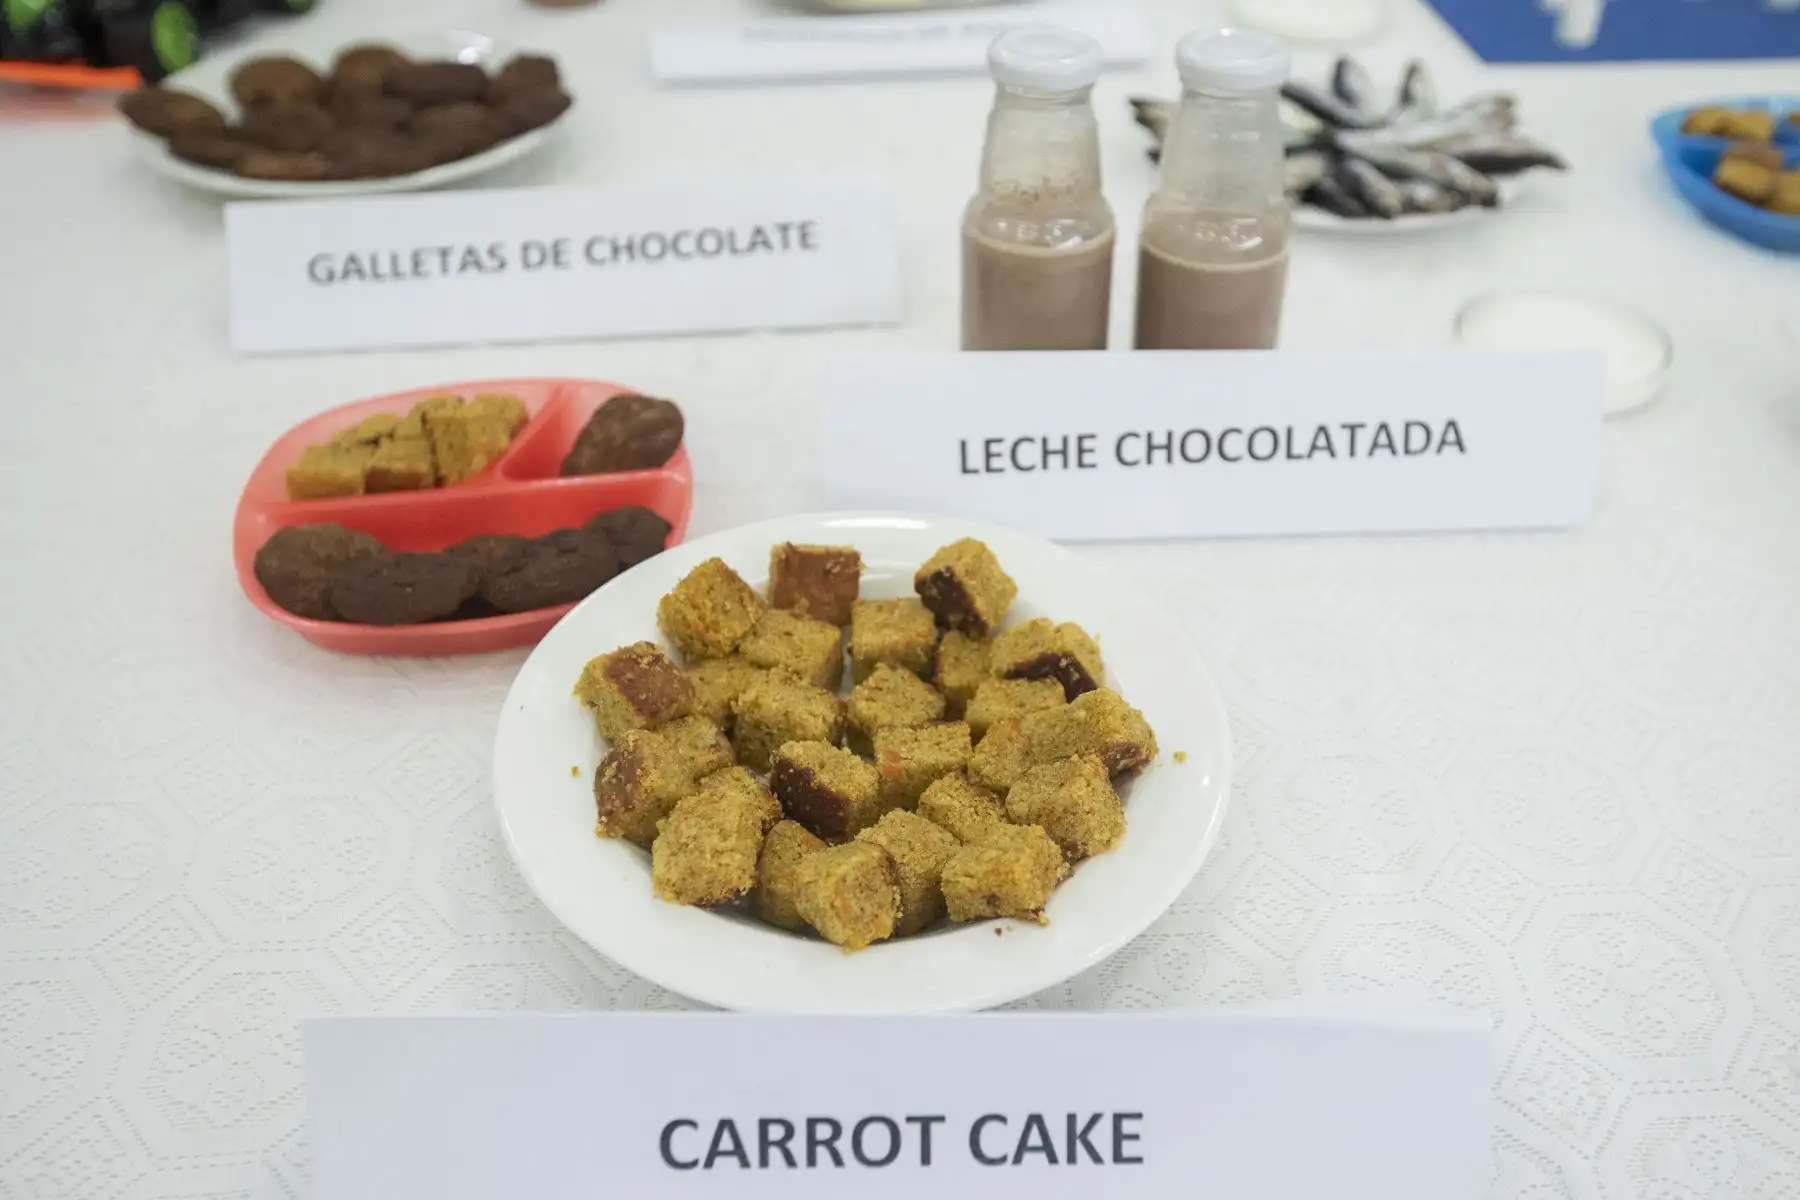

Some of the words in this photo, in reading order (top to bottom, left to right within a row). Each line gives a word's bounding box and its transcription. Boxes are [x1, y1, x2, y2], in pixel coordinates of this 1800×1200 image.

[307, 245, 508, 285] GALLETAS
[521, 238, 570, 271] DE
[584, 220, 818, 265] CHOCOLATE
[960, 434, 1098, 475] LECHE
[1115, 419, 1466, 467] CHOCOLATADA
[659, 1115, 946, 1171] CARROT
[968, 1112, 1144, 1166] CAKE
